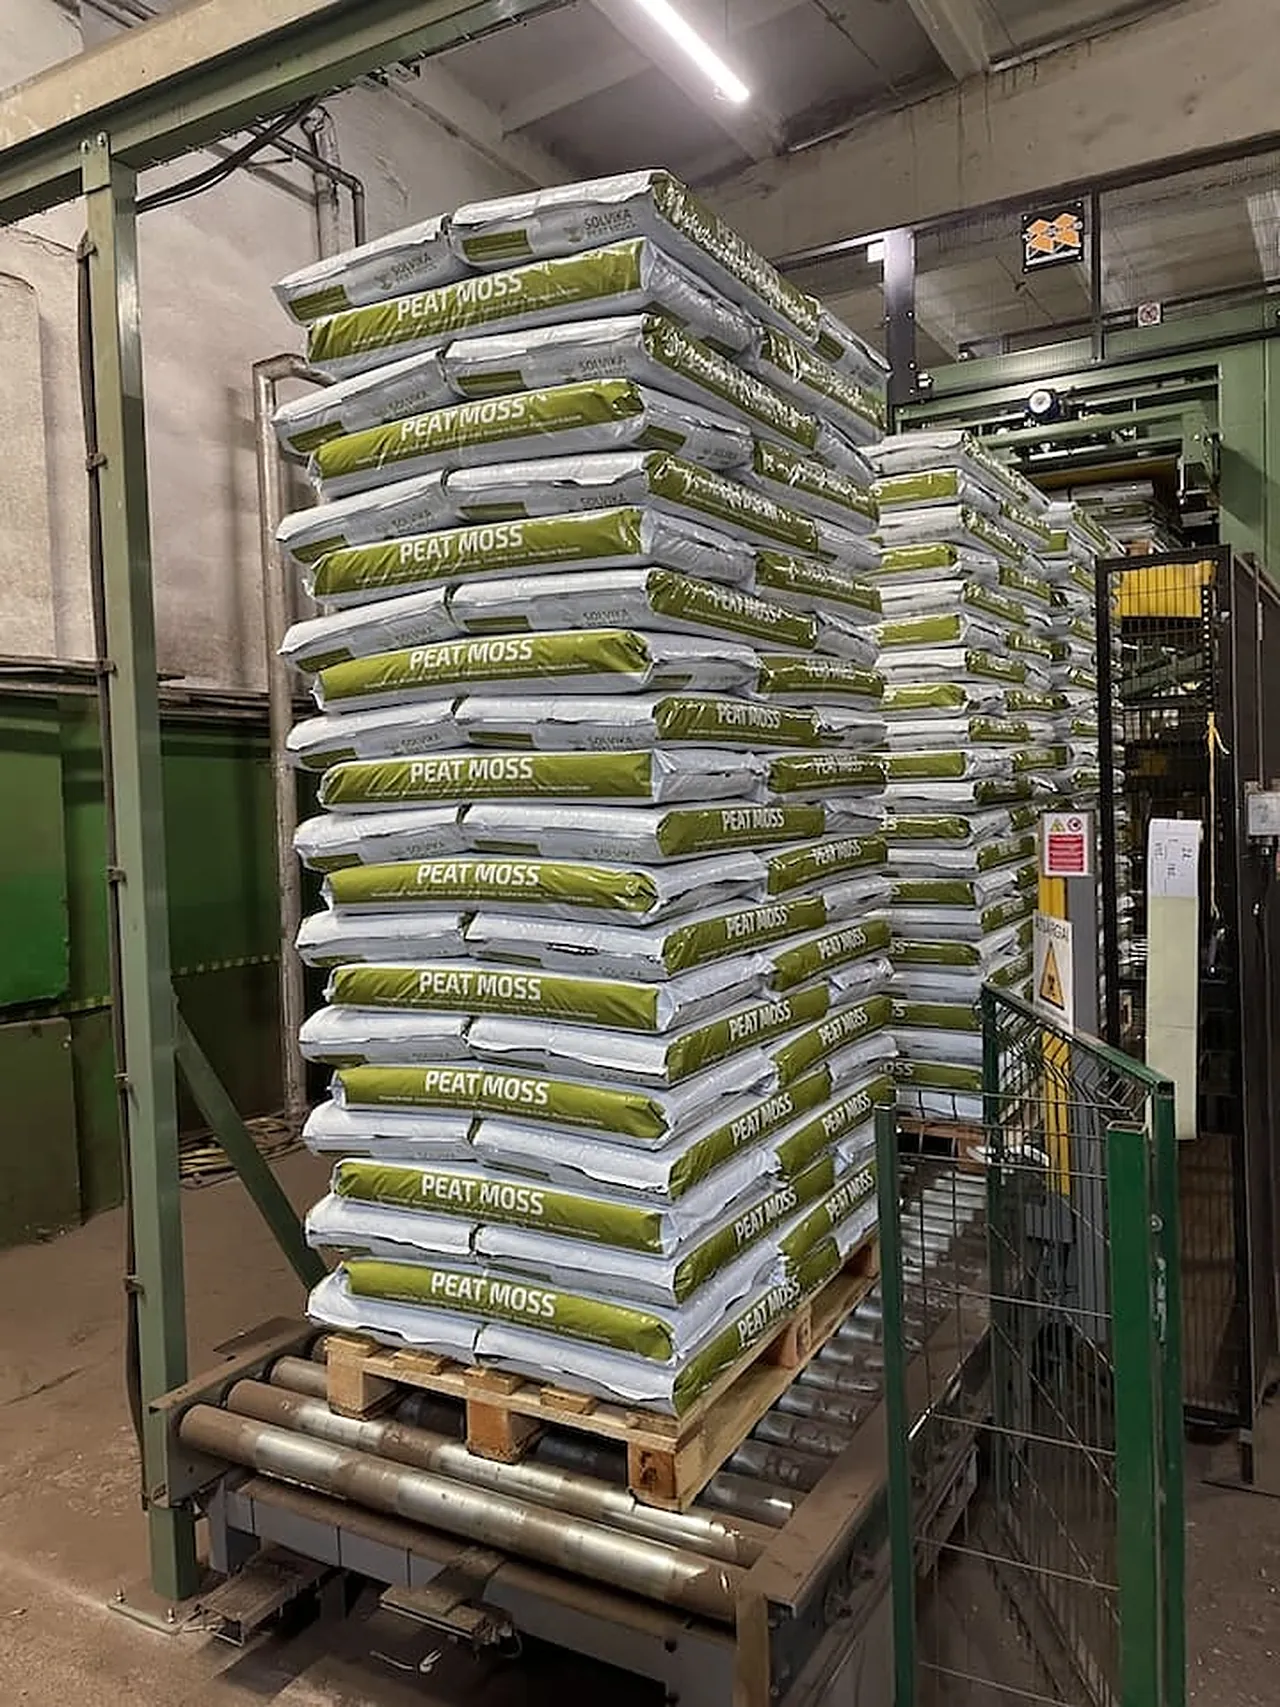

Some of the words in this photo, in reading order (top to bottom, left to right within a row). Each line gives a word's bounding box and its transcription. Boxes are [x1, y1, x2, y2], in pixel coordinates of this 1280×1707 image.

[397, 286, 453, 321] PEAT
[457, 273, 522, 305] MOSS
[401, 412, 456, 441] PEAT
[459, 400, 525, 426] MOSS
[400, 536, 453, 564] PEAT
[458, 525, 523, 551] MOSS
[411, 645, 463, 670] PEAT
[467, 639, 533, 662] MOSS
[717, 702, 748, 724] PEAT
[750, 706, 780, 728] MOSS
[410, 760, 464, 783] PEAT
[468, 757, 533, 779] MOSS
[722, 809, 751, 832] PEAT
[753, 808, 785, 828] MOSS
[417, 864, 471, 884] PEAT
[474, 864, 540, 886] MOSS
[725, 914, 755, 939] PEAT
[757, 905, 787, 930] MOSS
[420, 972, 472, 995] PEAT
[477, 974, 541, 1000] MOSS
[729, 1012, 759, 1041] PEAT
[760, 1000, 791, 1026] MOSS
[425, 1071, 480, 1095] PEAT
[481, 1075, 549, 1105] MOSS
[731, 1110, 761, 1145] PEAT
[761, 1092, 793, 1127] MOSS
[422, 1174, 475, 1203] PEAT
[480, 1183, 544, 1216] MOSS
[826, 1189, 849, 1223] PEAT
[848, 1169, 874, 1201] MOSS
[735, 1206, 766, 1245] PEAT
[766, 1187, 797, 1221] MOSS
[431, 1271, 487, 1301] PEAT
[489, 1282, 556, 1318] MOSS
[738, 1302, 766, 1341] PEAT
[770, 1276, 800, 1312] MOSS
